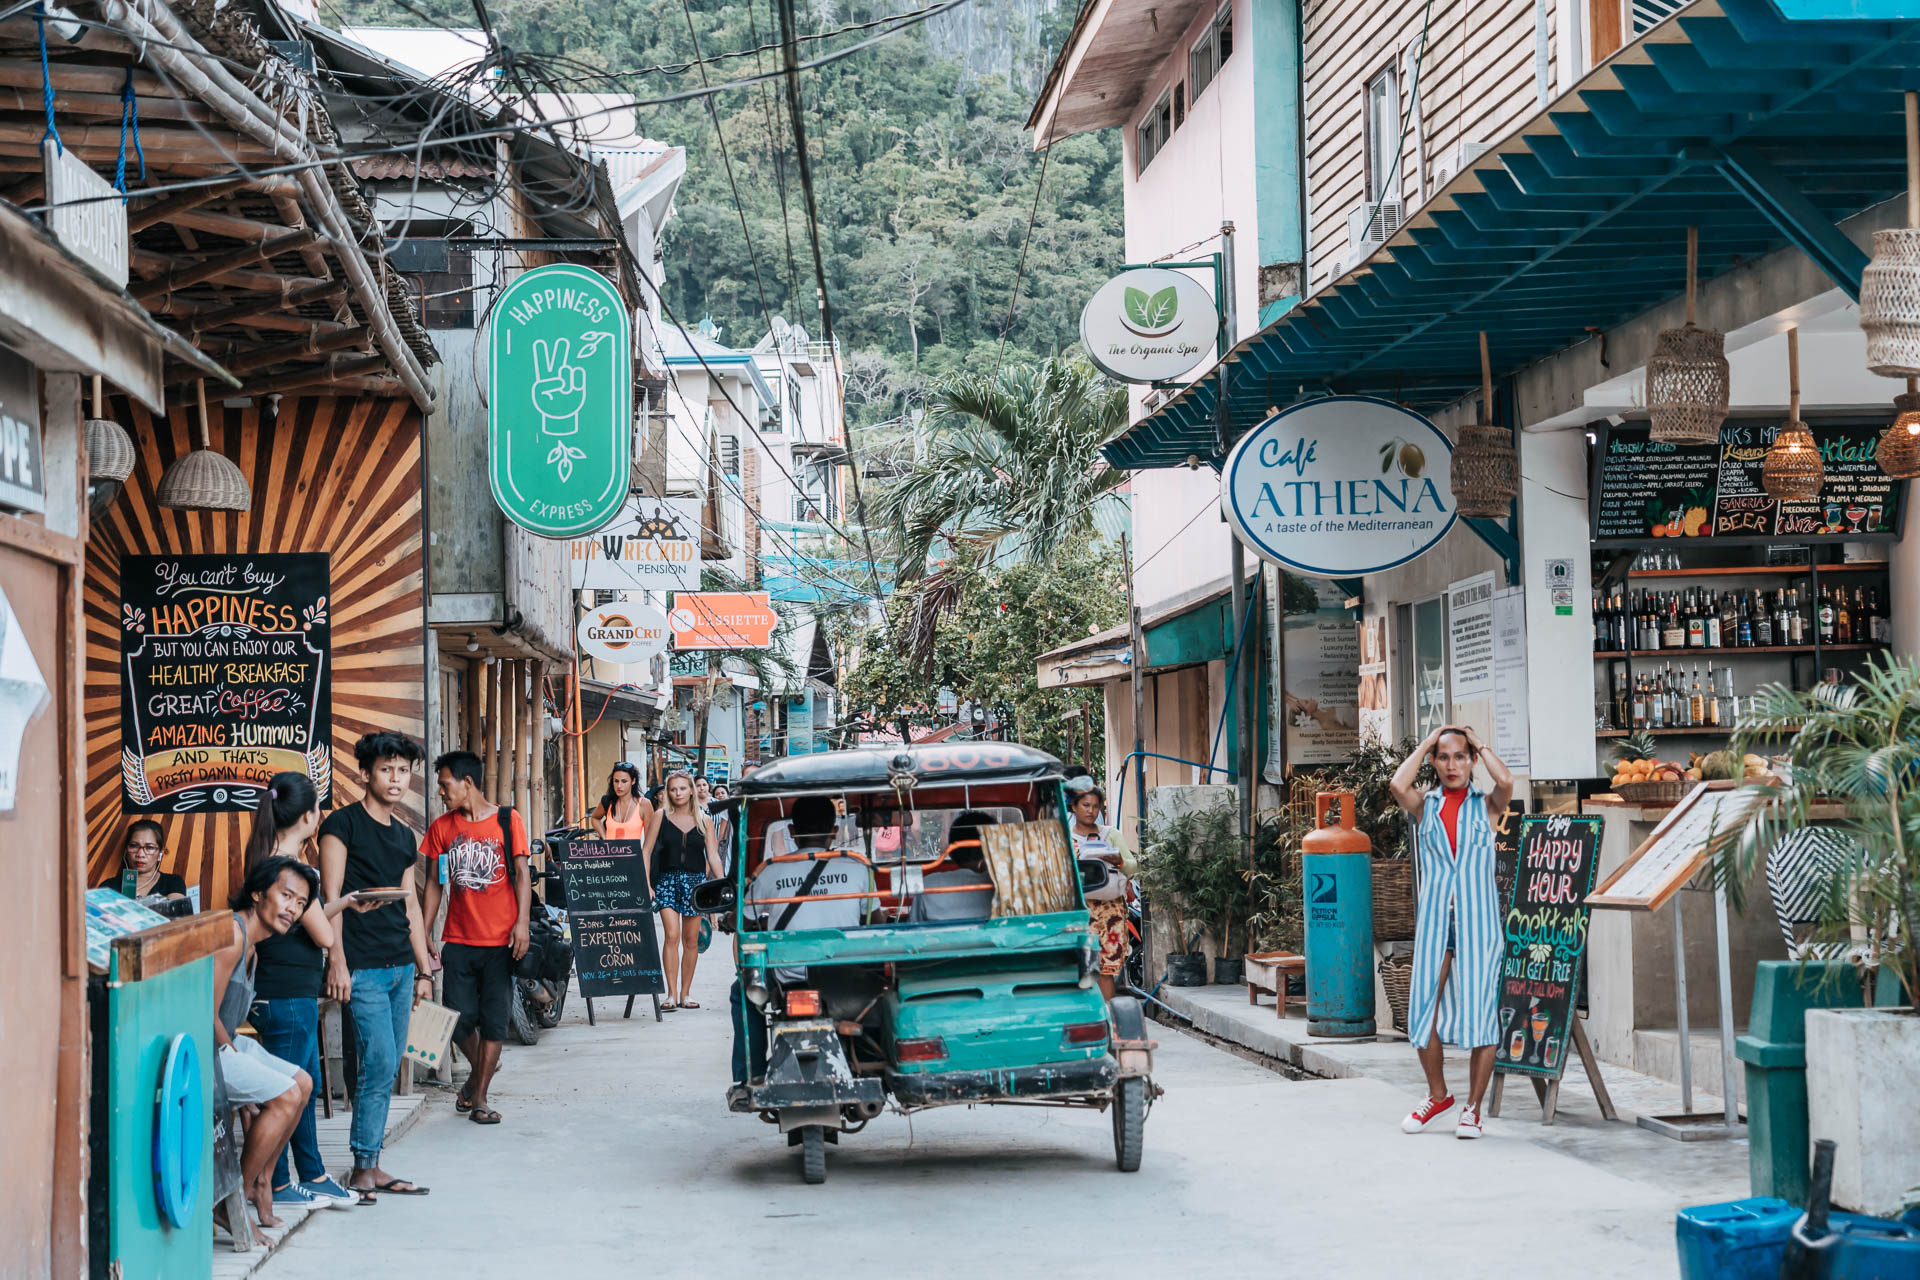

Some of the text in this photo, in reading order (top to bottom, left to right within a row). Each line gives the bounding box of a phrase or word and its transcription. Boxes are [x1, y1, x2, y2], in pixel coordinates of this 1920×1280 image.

[508, 288, 610, 325] HAPPINESS
[1108, 342, 1199, 360] The Organic Spa
[1259, 437, 1317, 477] Café
[1250, 477, 1448, 518] ATHENA
[529, 499, 593, 520] EXPRESS
[1265, 518, 1434, 534] A taste of the Mediterranean
[1718, 512, 1767, 533] BEER
[571, 535, 694, 562] HIPWRECKED
[155, 562, 286, 596] You can't buy
[637, 564, 687, 574] PENSION
[152, 595, 297, 635] HAPPINESS
[153, 641, 298, 657] BUT YOU CAN ENJOY OUR
[148, 662, 309, 686] HEALTHY BREAKFAST
[148, 688, 290, 719] GREAT Coffee
[147, 724, 226, 746] AMAZING
[172, 750, 268, 767] AND THAT'S
[155, 766, 278, 790] PRETTY DAMN CLOS
[896, 778, 912, 786] STOP
[1547, 814, 1572, 838] Enjoy
[1527, 832, 1583, 873] HAPPY
[562, 861, 583, 870] Tours
[1528, 871, 1578, 904] HOUR
[580, 931, 642, 947] EXPEDITION
[1505, 907, 1589, 958] Cocktails
[599, 953, 634, 968] CORON
[608, 945, 620, 955] TO
[1505, 957, 1572, 982] BUY 1 GET 1 FREE
[1506, 980, 1526, 995] FROM
